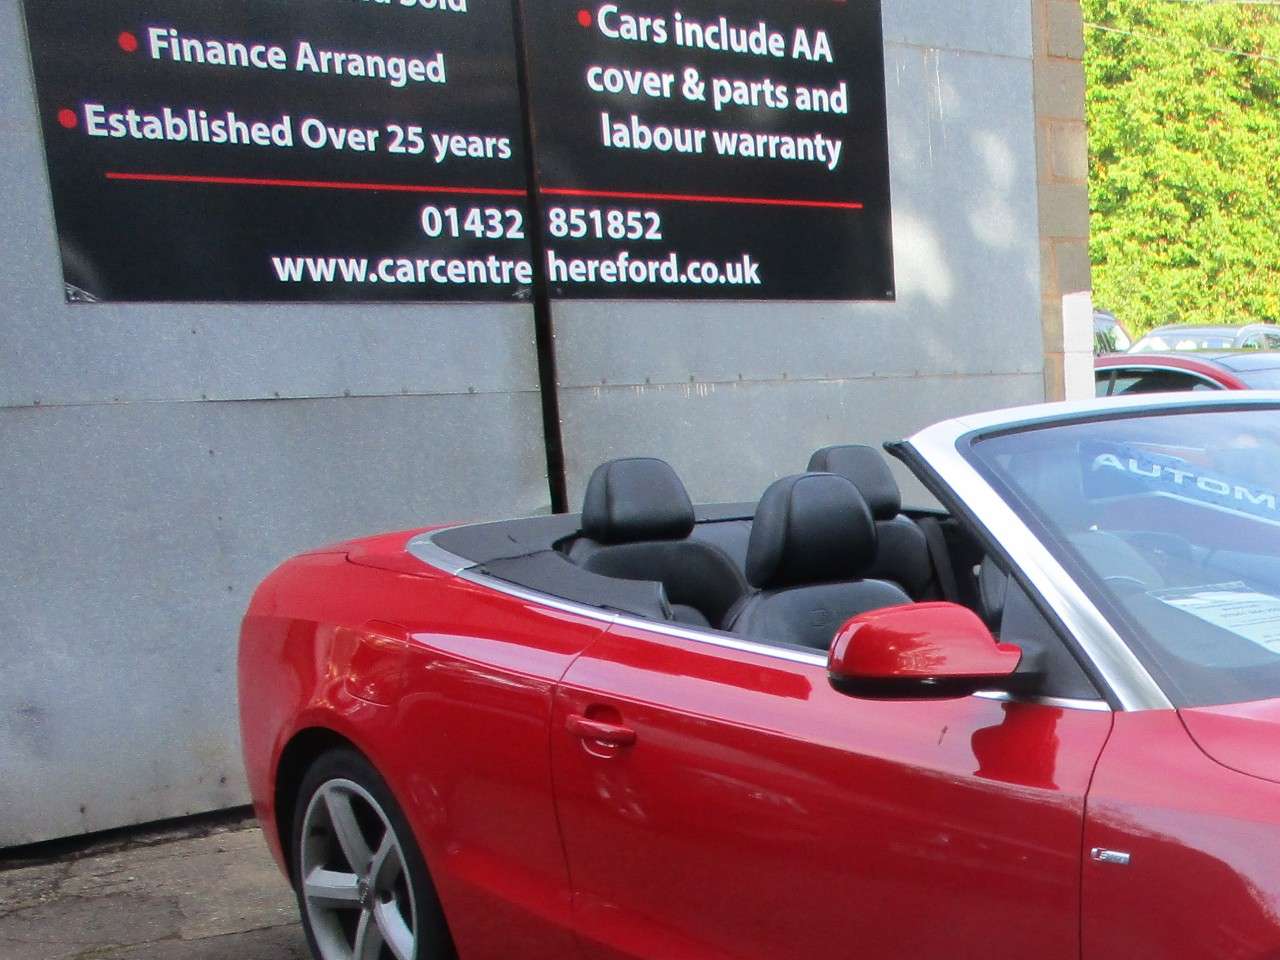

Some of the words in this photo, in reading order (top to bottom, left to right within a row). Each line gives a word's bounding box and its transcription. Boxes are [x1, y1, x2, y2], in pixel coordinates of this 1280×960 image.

[147, 27, 287, 70] Finance
[295, 41, 446, 88] Arranged
[596, 3, 668, 44] Cars
[673, 10, 785, 57] include
[791, 27, 834, 63] AA
[586, 65, 675, 98] cover
[681, 66, 706, 102] &
[712, 77, 789, 111] parts
[794, 81, 848, 114] and
[84, 103, 294, 147] Established
[300, 118, 380, 152] Over
[386, 124, 425, 154] 25
[430, 133, 512, 164] years
[601, 111, 707, 154] labour
[711, 130, 842, 171] warranty
[421, 205, 525, 239] 01432
[548, 207, 662, 240] 851852
